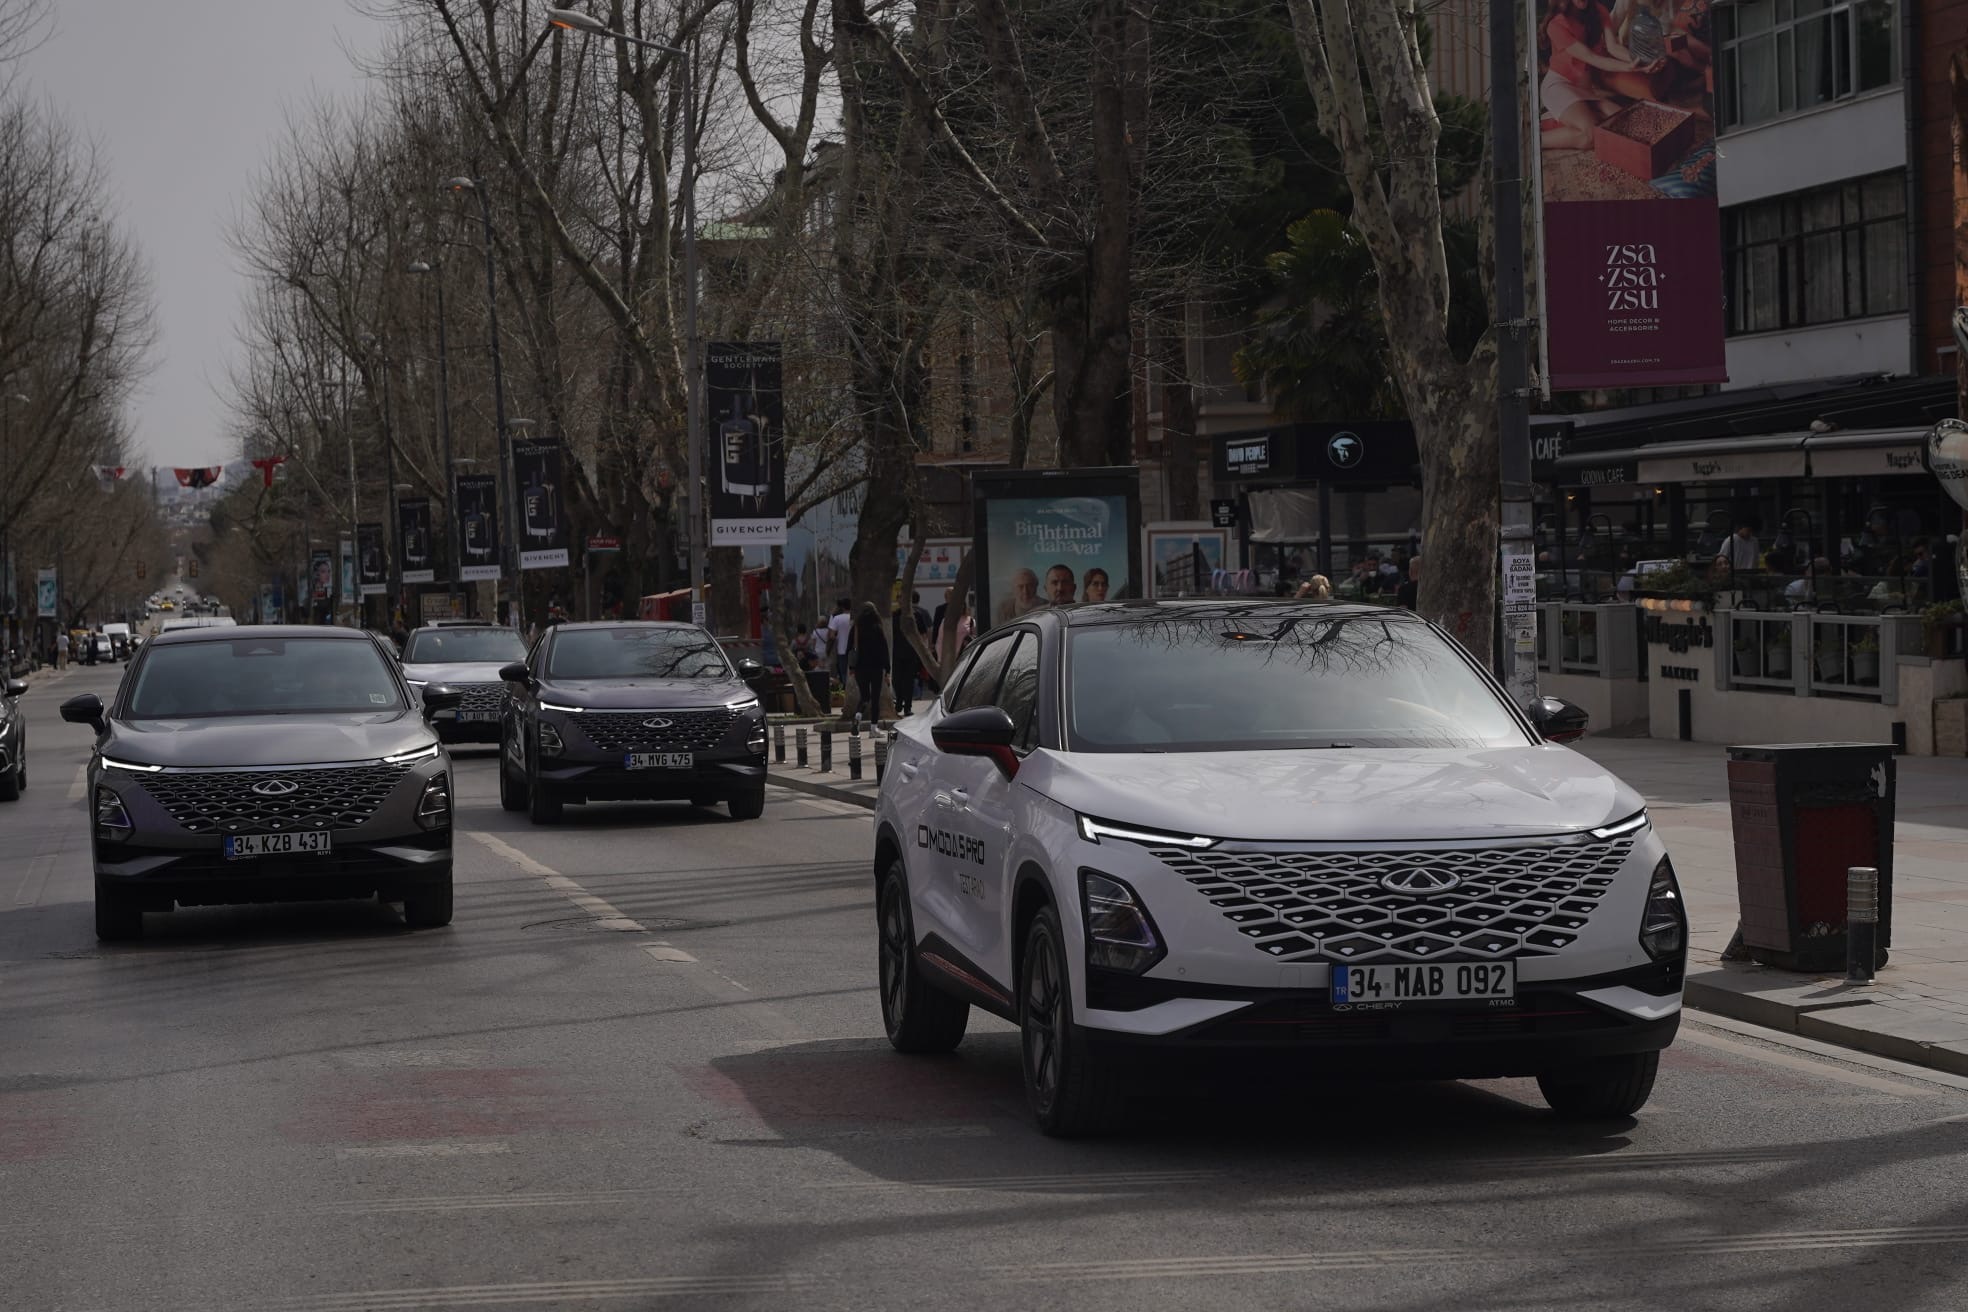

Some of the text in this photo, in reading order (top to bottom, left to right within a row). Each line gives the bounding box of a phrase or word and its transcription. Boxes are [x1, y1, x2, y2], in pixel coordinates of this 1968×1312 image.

[1606, 244, 1656, 265] zsa
[1608, 266, 1657, 288] zsa
[1608, 289, 1658, 310] zsu
[711, 355, 776, 364] GENTLEMAN
[1535, 431, 1562, 461] CAFÉ
[1581, 466, 1625, 485] GODIVA CAFÉ
[717, 525, 780, 534] GIVENCHY
[1015, 518, 1041, 536] Bir
[1039, 523, 1103, 540] ihtimal
[1034, 538, 1103, 556] daha var
[1661, 665, 1699, 681] BAKERY
[631, 754, 643, 766] 34
[671, 754, 690, 765] 475
[235, 832, 328, 854] 34 KZB 437
[918, 825, 958, 858] OMODA
[966, 836, 985, 865] PRO
[1350, 965, 1506, 997] 34 MAB 092
[1335, 987, 1347, 996] TR
[1356, 1000, 1515, 1010] CHERY ATMO
